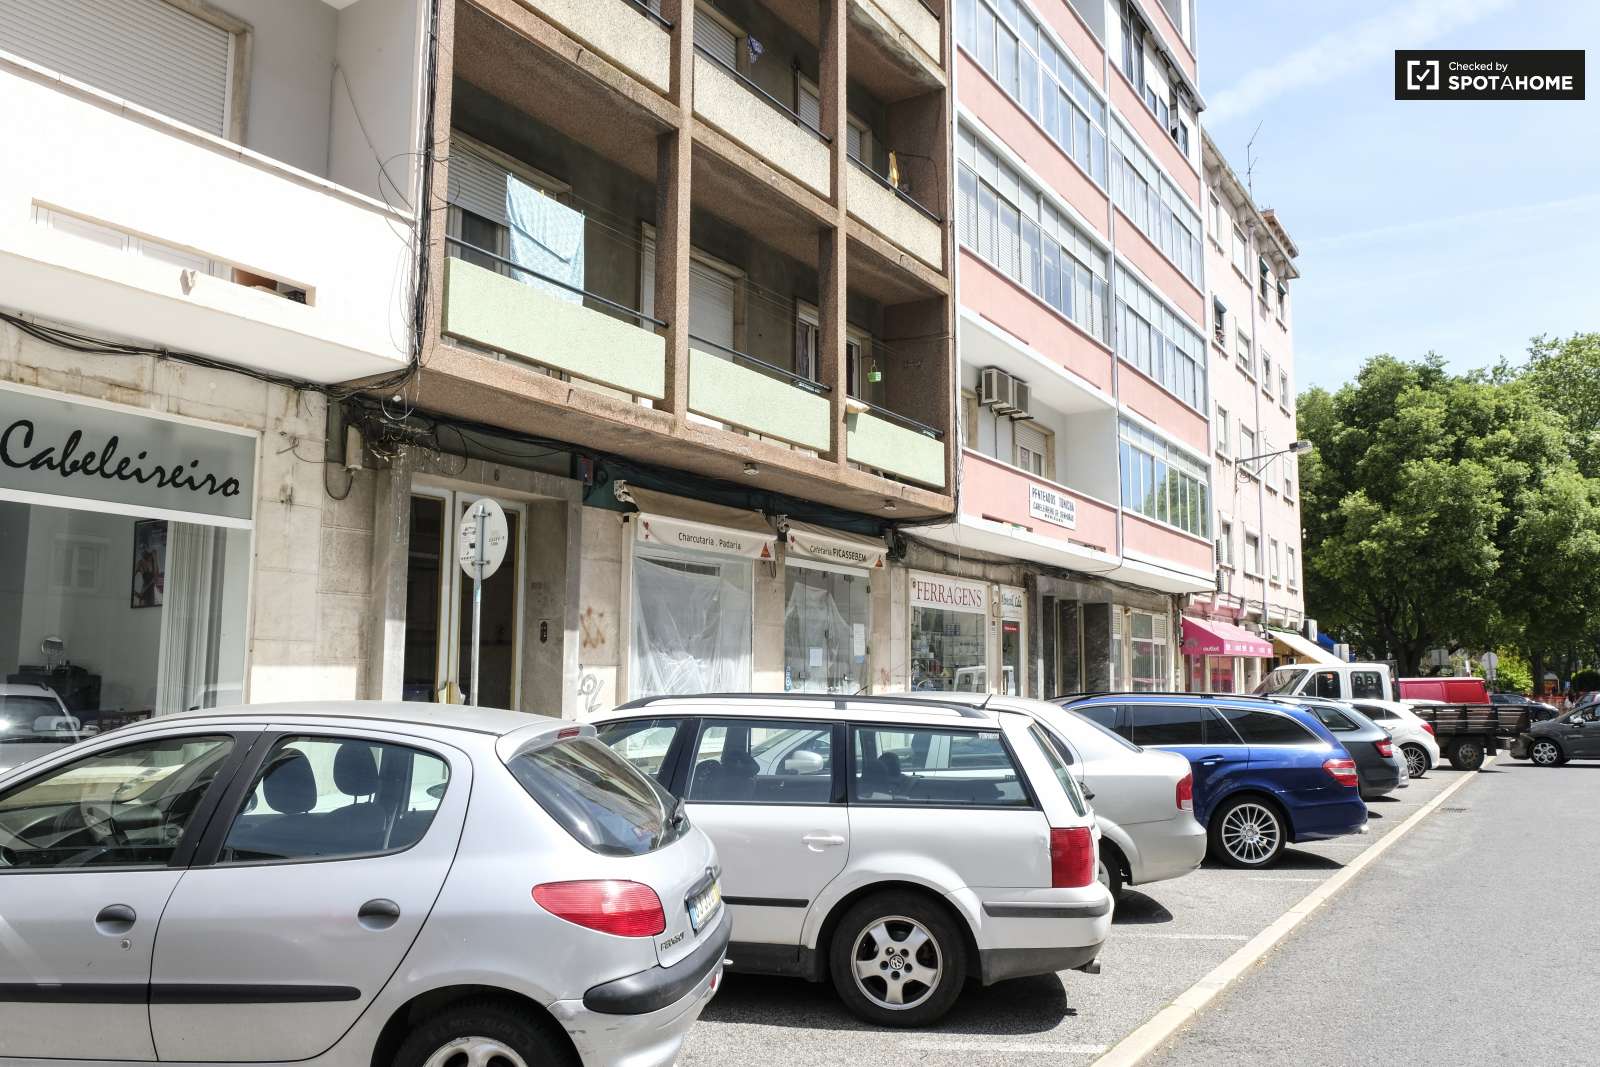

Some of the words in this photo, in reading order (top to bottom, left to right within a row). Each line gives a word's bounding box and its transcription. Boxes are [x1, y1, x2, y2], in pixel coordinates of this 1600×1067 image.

[0, 419, 240, 497] Cabeleireiro
[678, 532, 714, 546] Charcutaria
[719, 538, 742, 550] Padaria
[832, 547, 867, 562] FICASSEBEM
[916, 580, 982, 608] FERRAGENS
